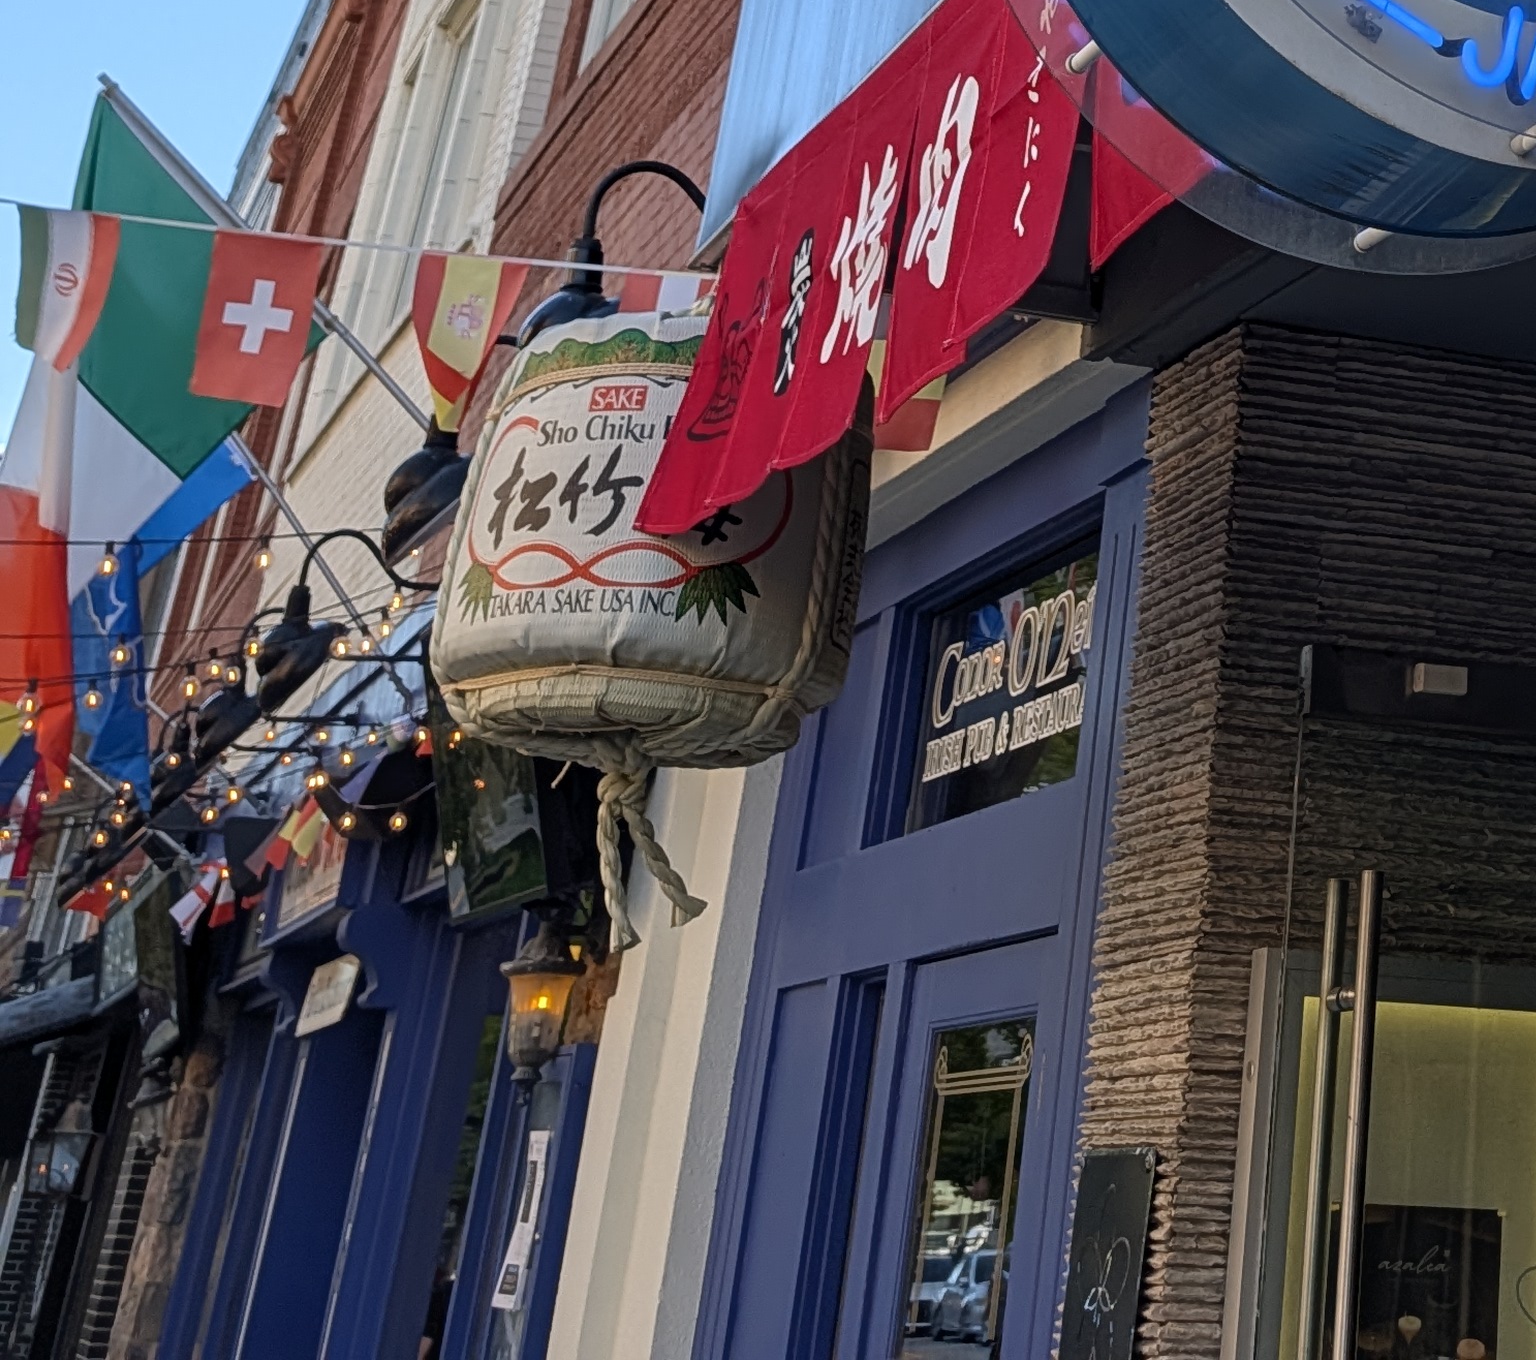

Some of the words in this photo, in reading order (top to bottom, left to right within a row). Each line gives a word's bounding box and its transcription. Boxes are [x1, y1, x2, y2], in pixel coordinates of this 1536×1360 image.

[591, 387, 645, 411] SAKE
[537, 420, 577, 446] Sho
[586, 415, 654, 443] Chiku
[490, 590, 546, 618] TAKARA
[552, 589, 593, 613] SAKE
[600, 590, 634, 615] USA
[639, 590, 675, 616] INC.
[1008, 584, 1096, 697] O'Nei
[922, 728, 966, 782] IRISH
[963, 717, 995, 768] PUB
[995, 711, 1009, 755] &
[1009, 683, 1086, 750] RESTAUR
[1378, 1245, 1449, 1273] azalea
